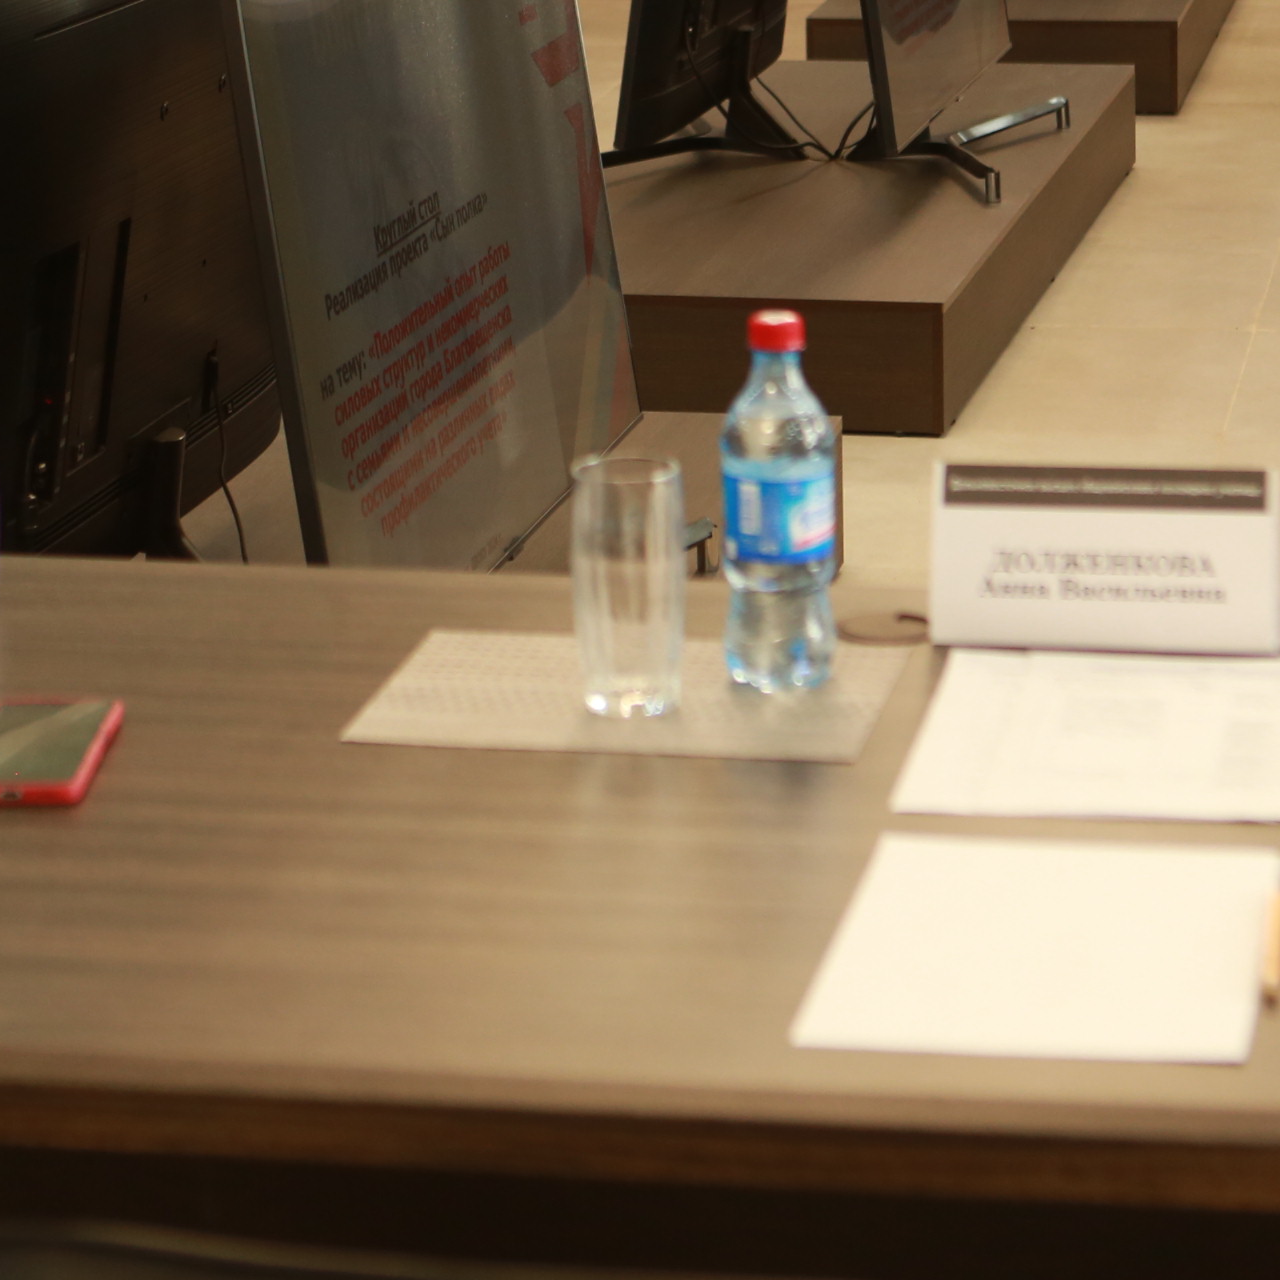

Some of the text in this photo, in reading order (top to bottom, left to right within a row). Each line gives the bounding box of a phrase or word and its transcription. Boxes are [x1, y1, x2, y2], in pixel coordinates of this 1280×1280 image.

[324, 191, 488, 321] Реализация проекта «Сын полка»
[373, 190, 440, 252] Круглый стол
[321, 240, 511, 401] на тему: «Положительный опыт работы
[334, 273, 509, 427] силовых структур и некоммерческих
[410, 360, 444, 403] города
[443, 304, 512, 374] Благовещенска
[347, 473, 356, 492] с
[356, 431, 402, 484] семьями
[361, 448, 424, 518] состоящими
[424, 437, 438, 461] на
[438, 393, 489, 456] различных
[992, 549, 1217, 578] ДОЛЖЕНКОВА
